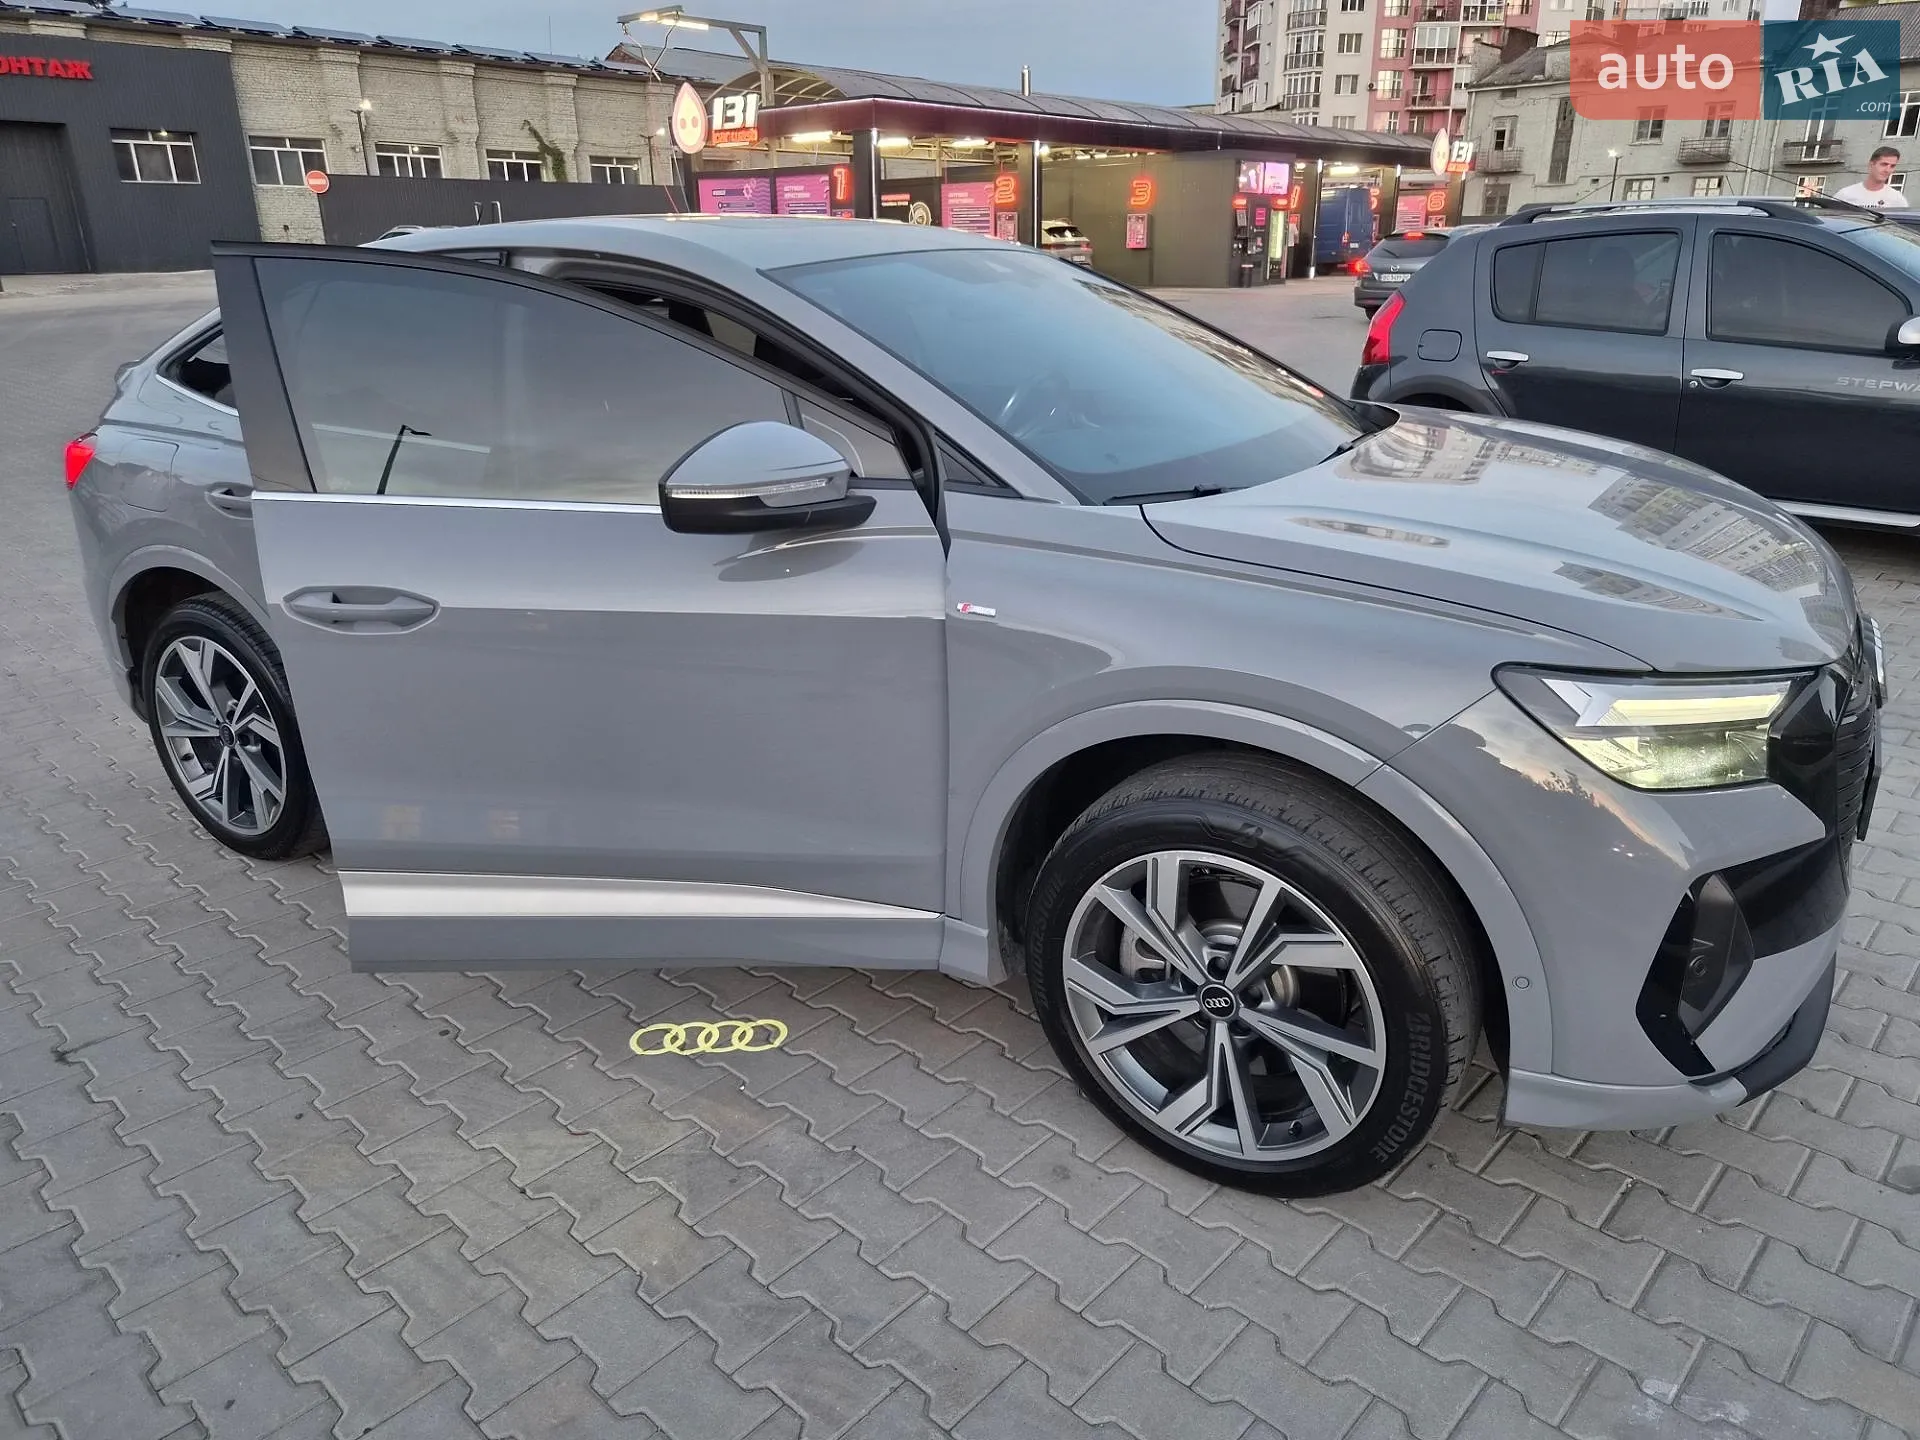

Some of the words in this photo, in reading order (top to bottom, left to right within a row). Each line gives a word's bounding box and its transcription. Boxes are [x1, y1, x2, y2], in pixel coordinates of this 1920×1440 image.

[833, 167, 846, 200] 1
[995, 176, 1015, 204] 2
[1130, 179, 1152, 206] 3
[1427, 190, 1447, 212] 6
[1369, 1011, 1432, 1164] BRIDGESTONE
